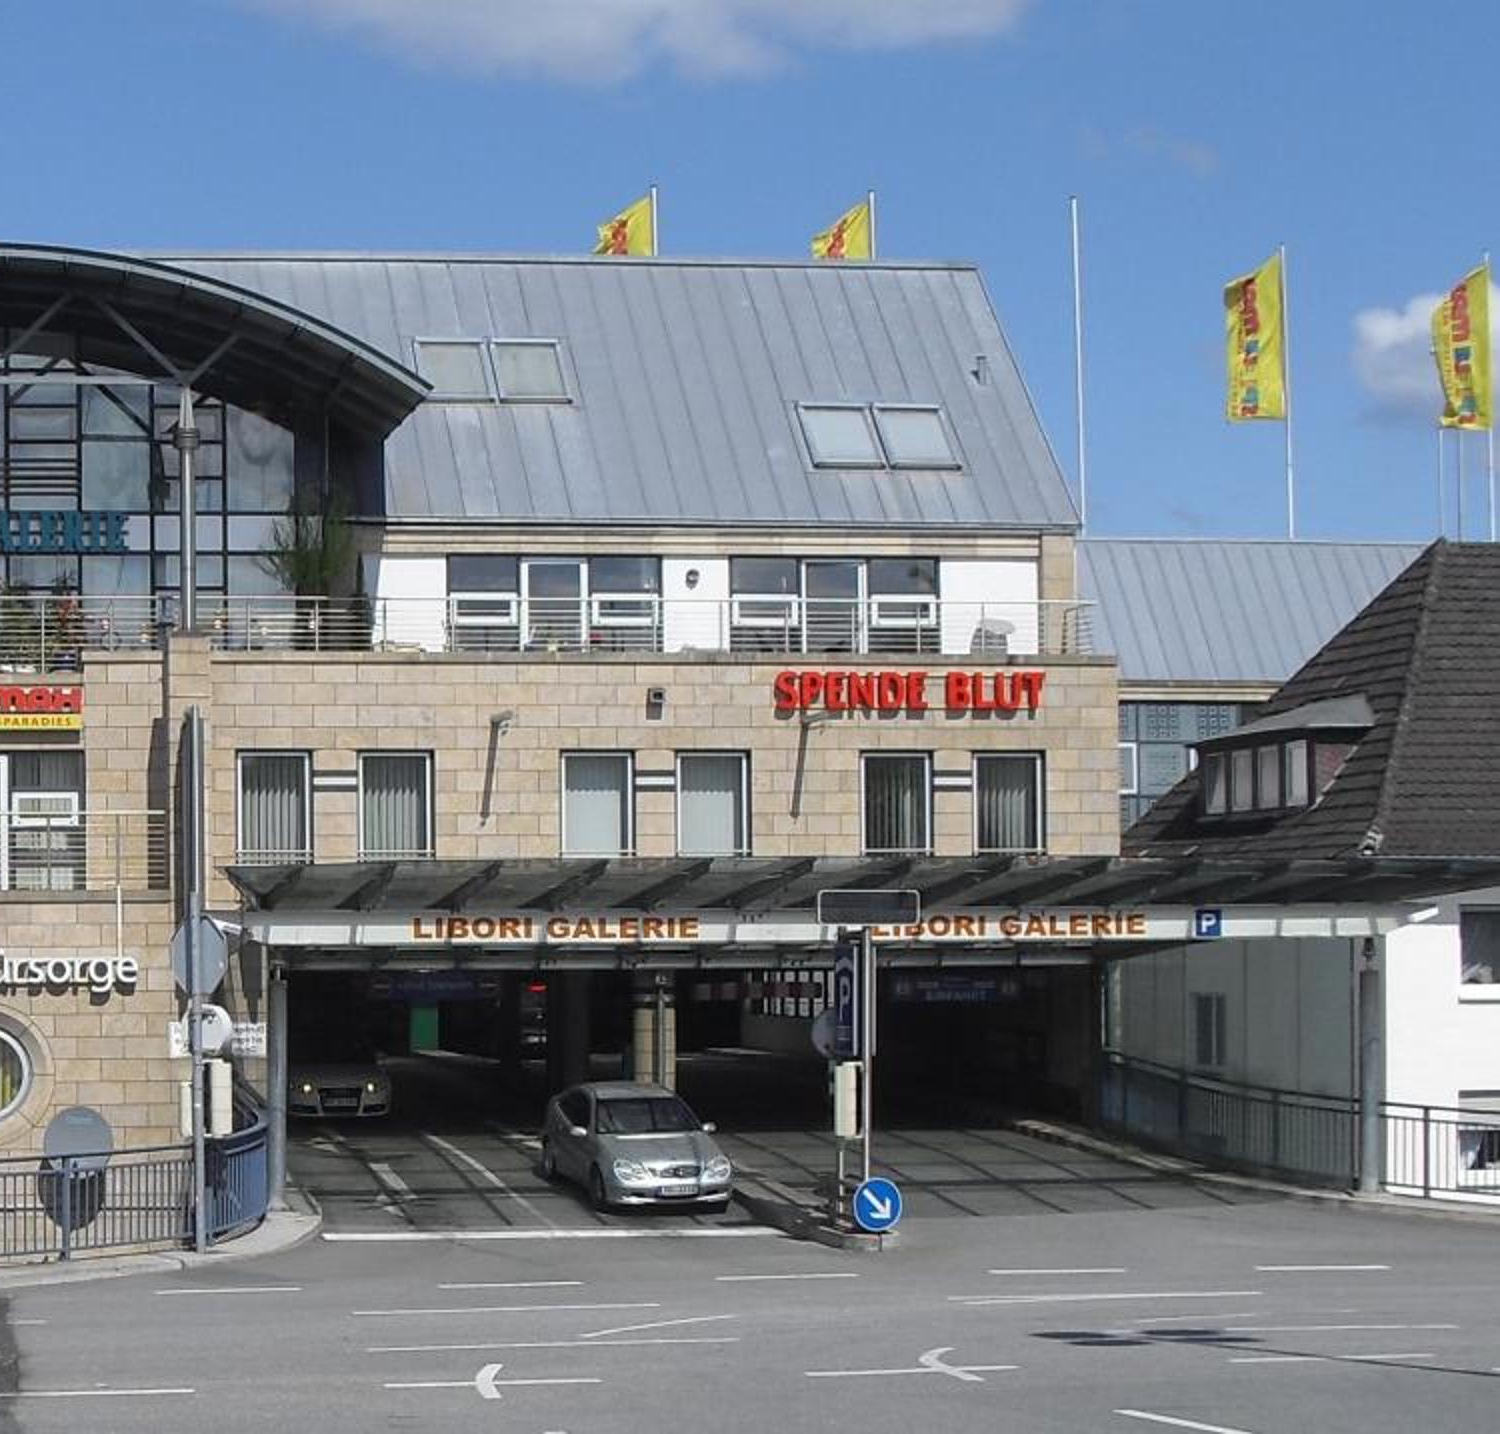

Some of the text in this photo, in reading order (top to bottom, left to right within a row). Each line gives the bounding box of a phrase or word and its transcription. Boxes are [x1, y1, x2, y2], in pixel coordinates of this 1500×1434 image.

[773, 670, 1046, 712] SPENDE BLUT
[412, 916, 700, 939] LIBORI GALERIE
[999, 913, 1147, 937] GALERIE
[1202, 914, 1217, 933] P
